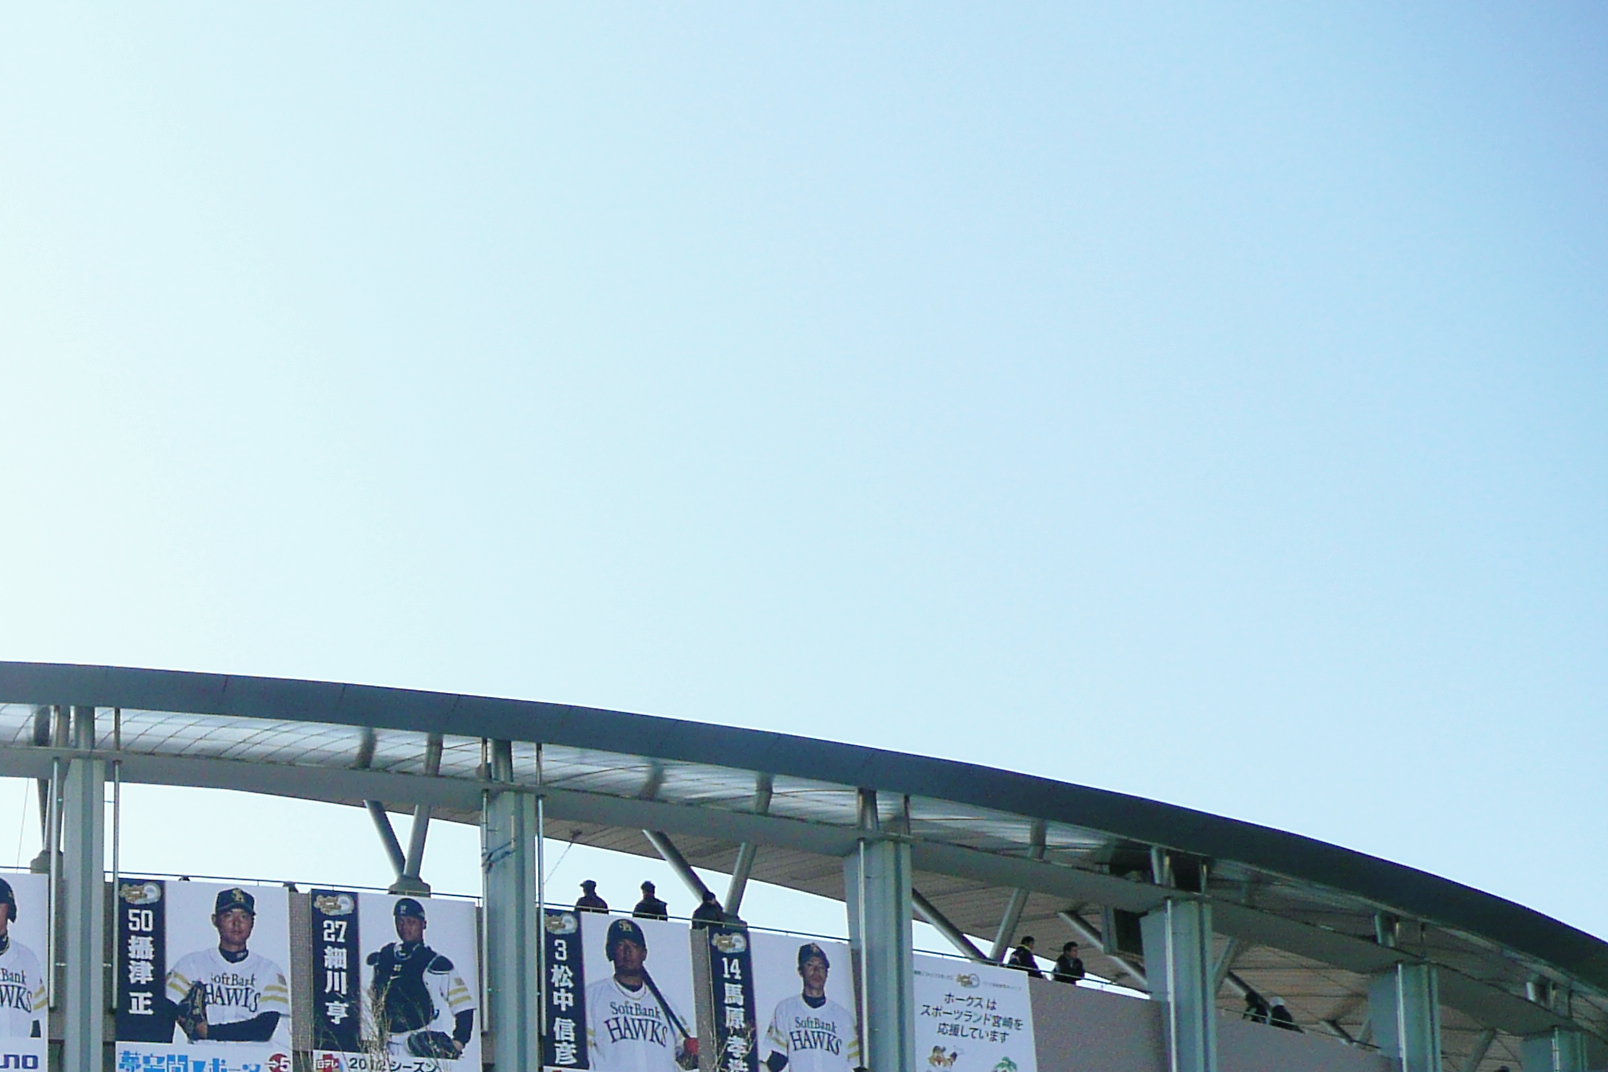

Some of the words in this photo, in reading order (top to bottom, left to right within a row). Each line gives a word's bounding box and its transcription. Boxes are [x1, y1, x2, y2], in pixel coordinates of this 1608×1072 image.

[128, 908, 154, 932] 50
[323, 919, 348, 943] 27
[553, 940, 568, 962] 3
[323, 947, 348, 996] 細川
[721, 957, 741, 980] 14
[550, 963, 575, 1012] 松中
[128, 992, 155, 1015] 正
[610, 1001, 661, 1020] SoftBank
[722, 981, 746, 1030] 馬原
[795, 1016, 838, 1033] SoftBank
[920, 1003, 1024, 1032] スポーツランド宮崎を
[552, 1018, 580, 1067] 信彦
[604, 1016, 669, 1048] HAWKS
[789, 1030, 842, 1056] HAWKS
[316, 1059, 340, 1071] 日テレ
